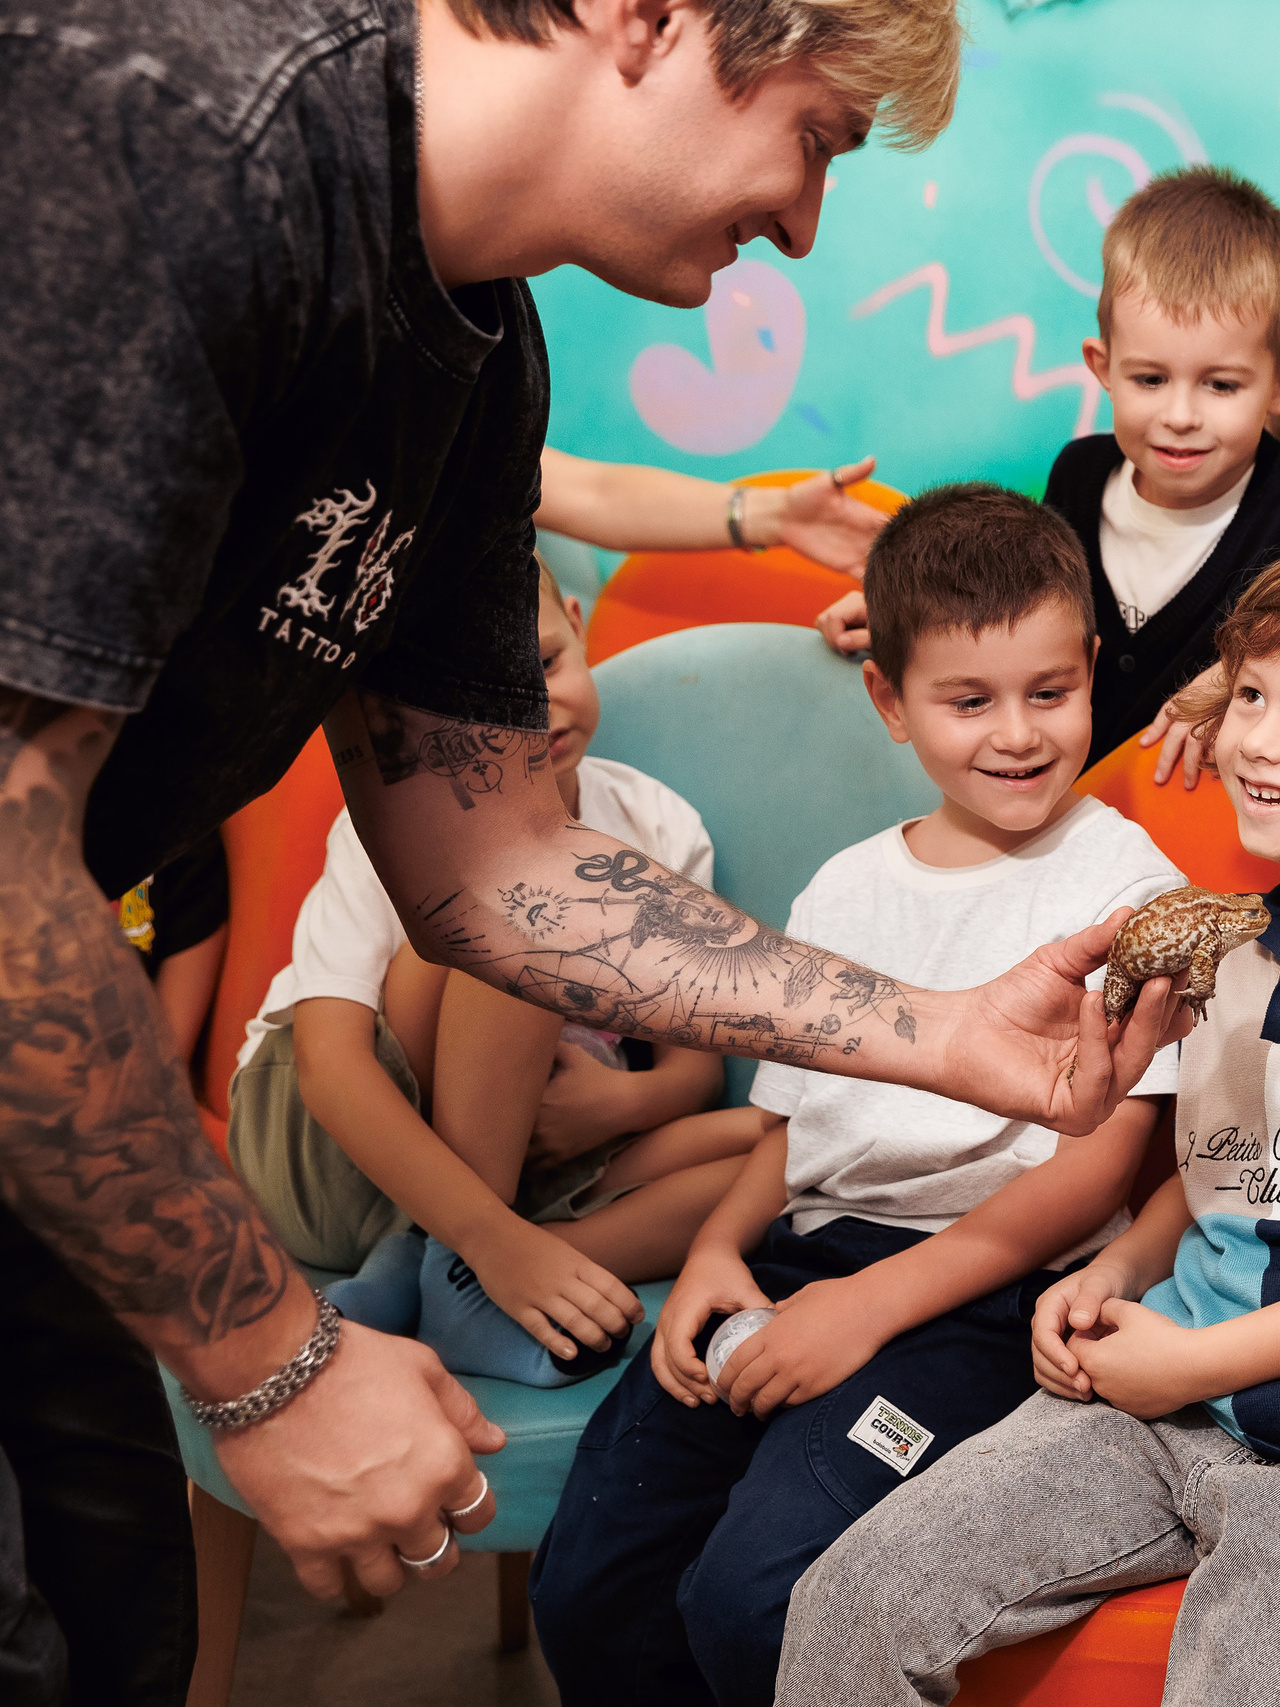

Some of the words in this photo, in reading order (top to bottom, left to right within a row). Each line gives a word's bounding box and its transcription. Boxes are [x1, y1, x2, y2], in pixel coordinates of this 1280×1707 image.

[258, 607, 356, 669] TATTOO
[1196, 1126, 1263, 1162] Petits
[870, 1418, 913, 1448] COURT
[877, 1405, 923, 1443] TENNIS
